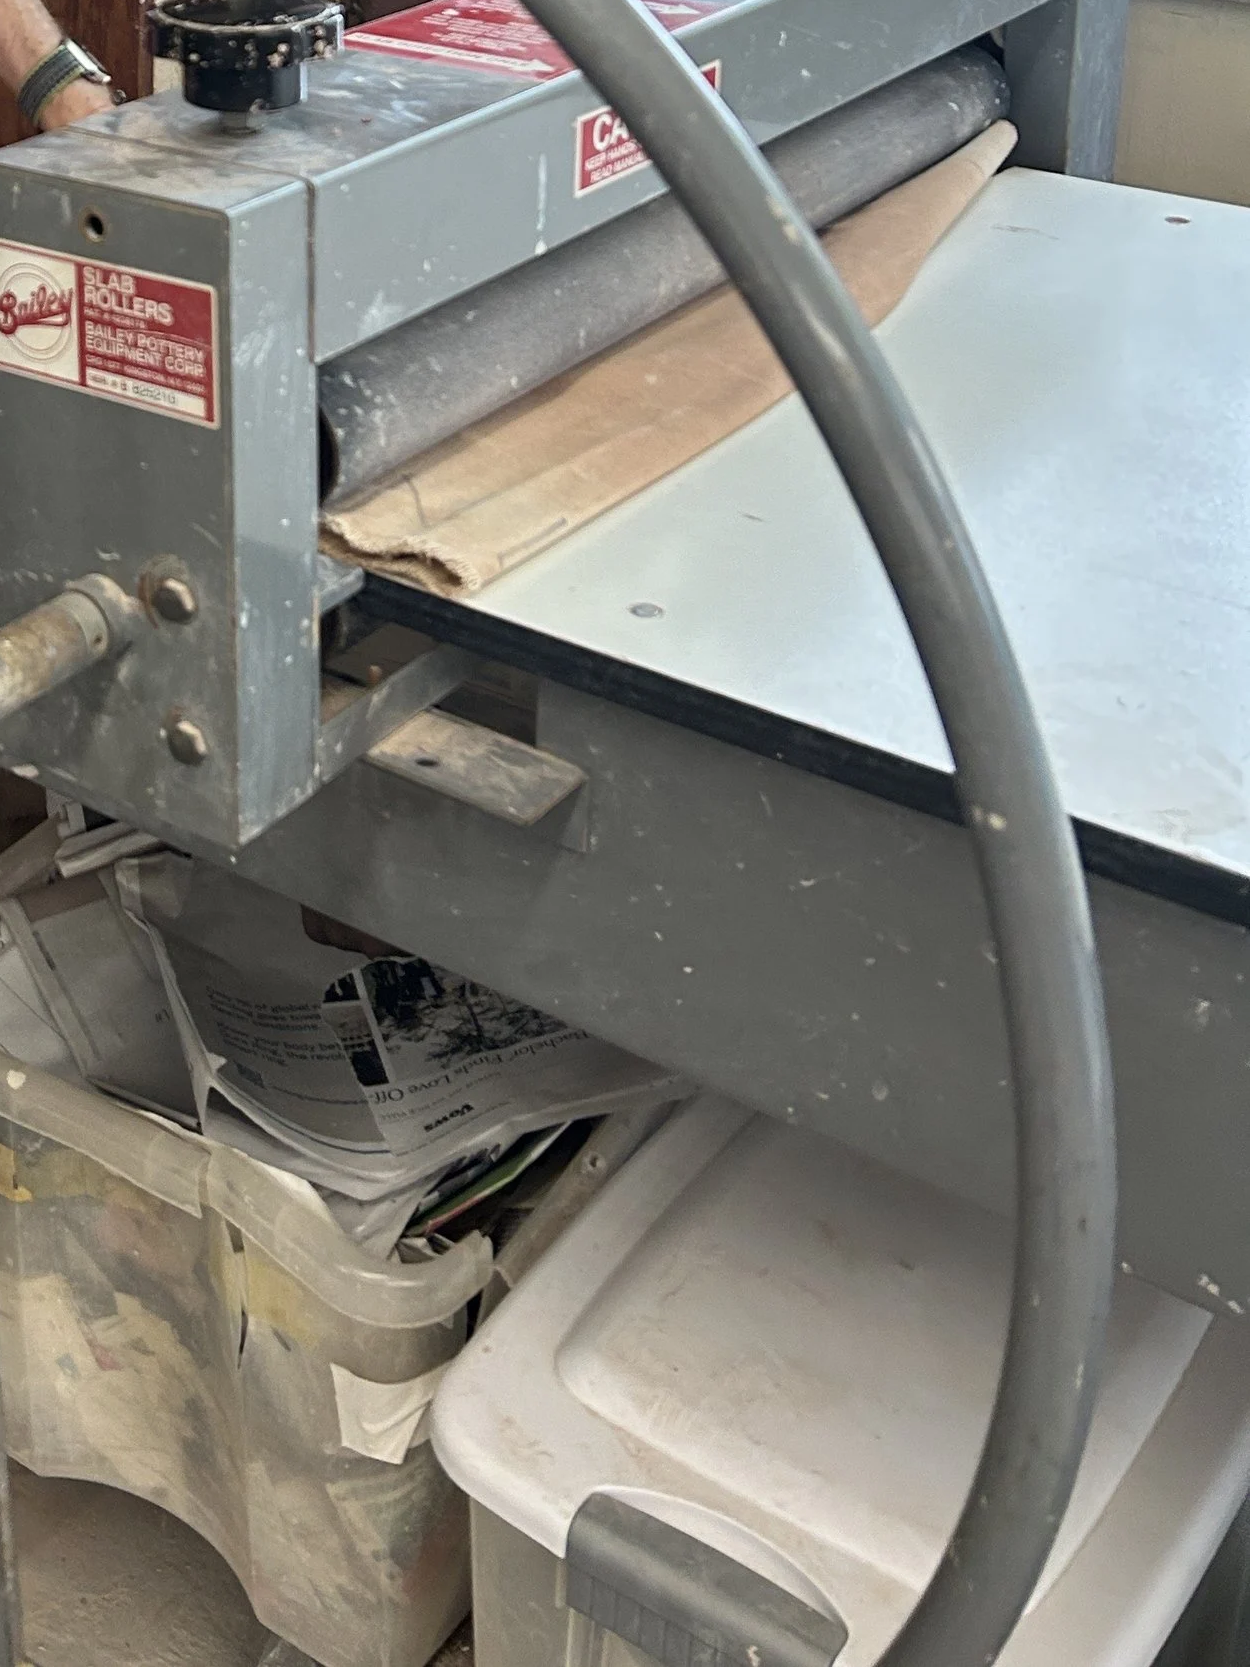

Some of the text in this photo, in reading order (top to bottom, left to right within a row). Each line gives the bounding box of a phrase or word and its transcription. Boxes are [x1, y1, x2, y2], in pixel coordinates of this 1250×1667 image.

[83, 266, 136, 295] SLAB
[84, 286, 173, 326] ROLLERS
[85, 320, 204, 359] BAILEY POTTERY
[86, 336, 162, 367] EQUIPMENT
